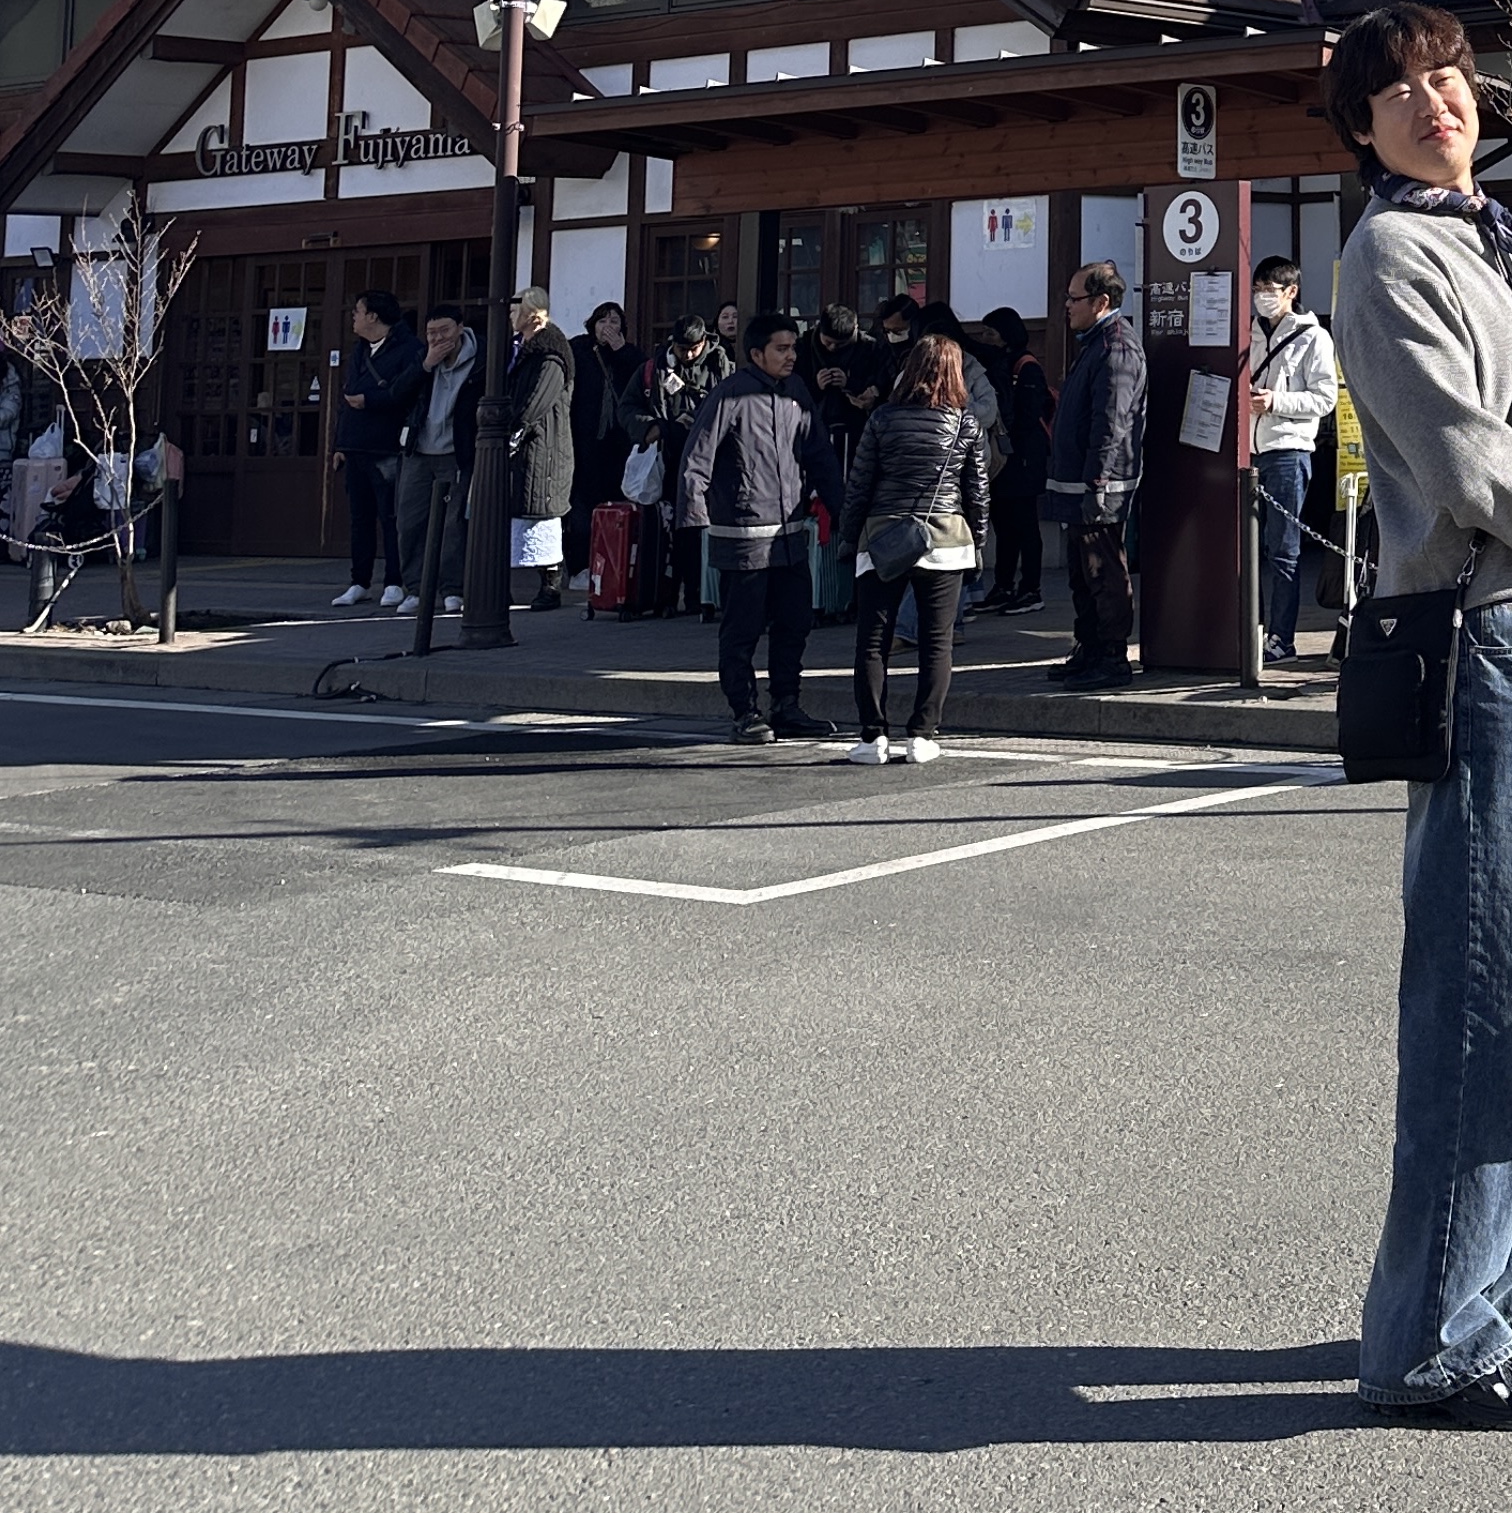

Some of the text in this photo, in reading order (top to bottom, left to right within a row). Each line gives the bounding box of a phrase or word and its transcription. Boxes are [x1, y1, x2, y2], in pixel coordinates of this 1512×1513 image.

[1191, 93, 1205, 126] 3
[195, 111, 471, 175] Gateway Fujiyama
[1179, 198, 1203, 244] 3
[1149, 309, 1184, 327] 新宿
